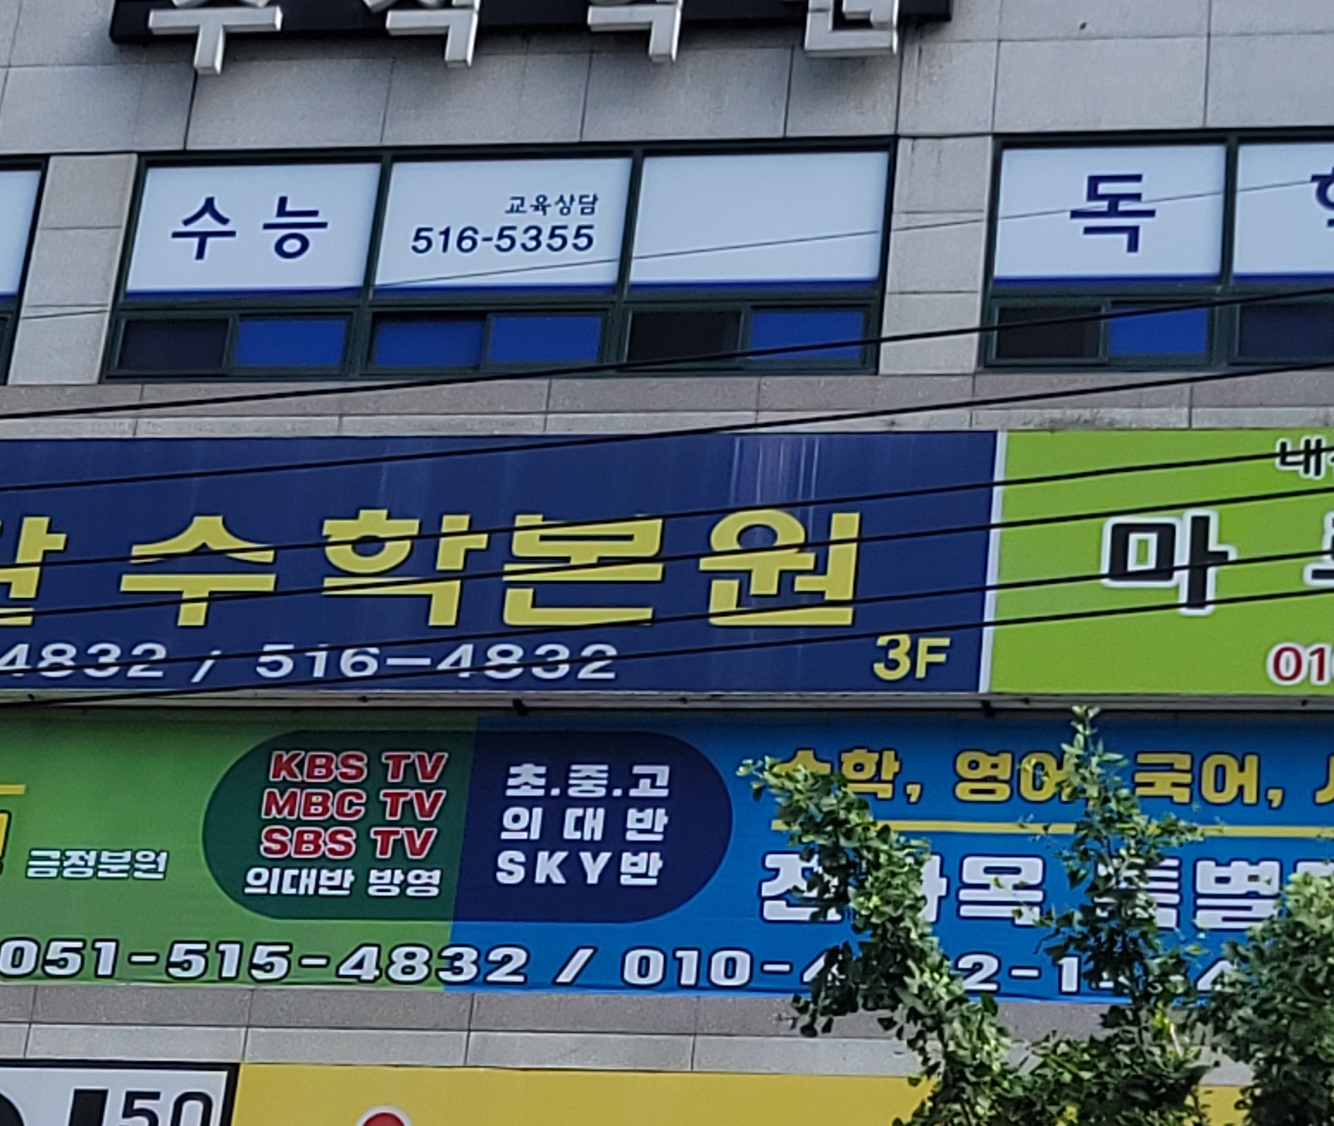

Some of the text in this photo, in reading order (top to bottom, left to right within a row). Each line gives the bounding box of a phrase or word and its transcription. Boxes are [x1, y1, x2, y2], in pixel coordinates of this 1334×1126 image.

[504, 192, 600, 217] 교육상담
[170, 195, 329, 261] 수능
[410, 224, 596, 255] 516-5355
[119, 508, 861, 628] 수학본원
[254, 642, 620, 681] 516-4832
[872, 633, 952, 681] 3F
[269, 750, 449, 783] KBS TV
[261, 789, 447, 821] MBC TV
[258, 827, 438, 861] SBS TV
[25, 848, 169, 882] 금정분원
[495, 850, 664, 887] SKY반
[244, 866, 443, 899] 의대반 방영
